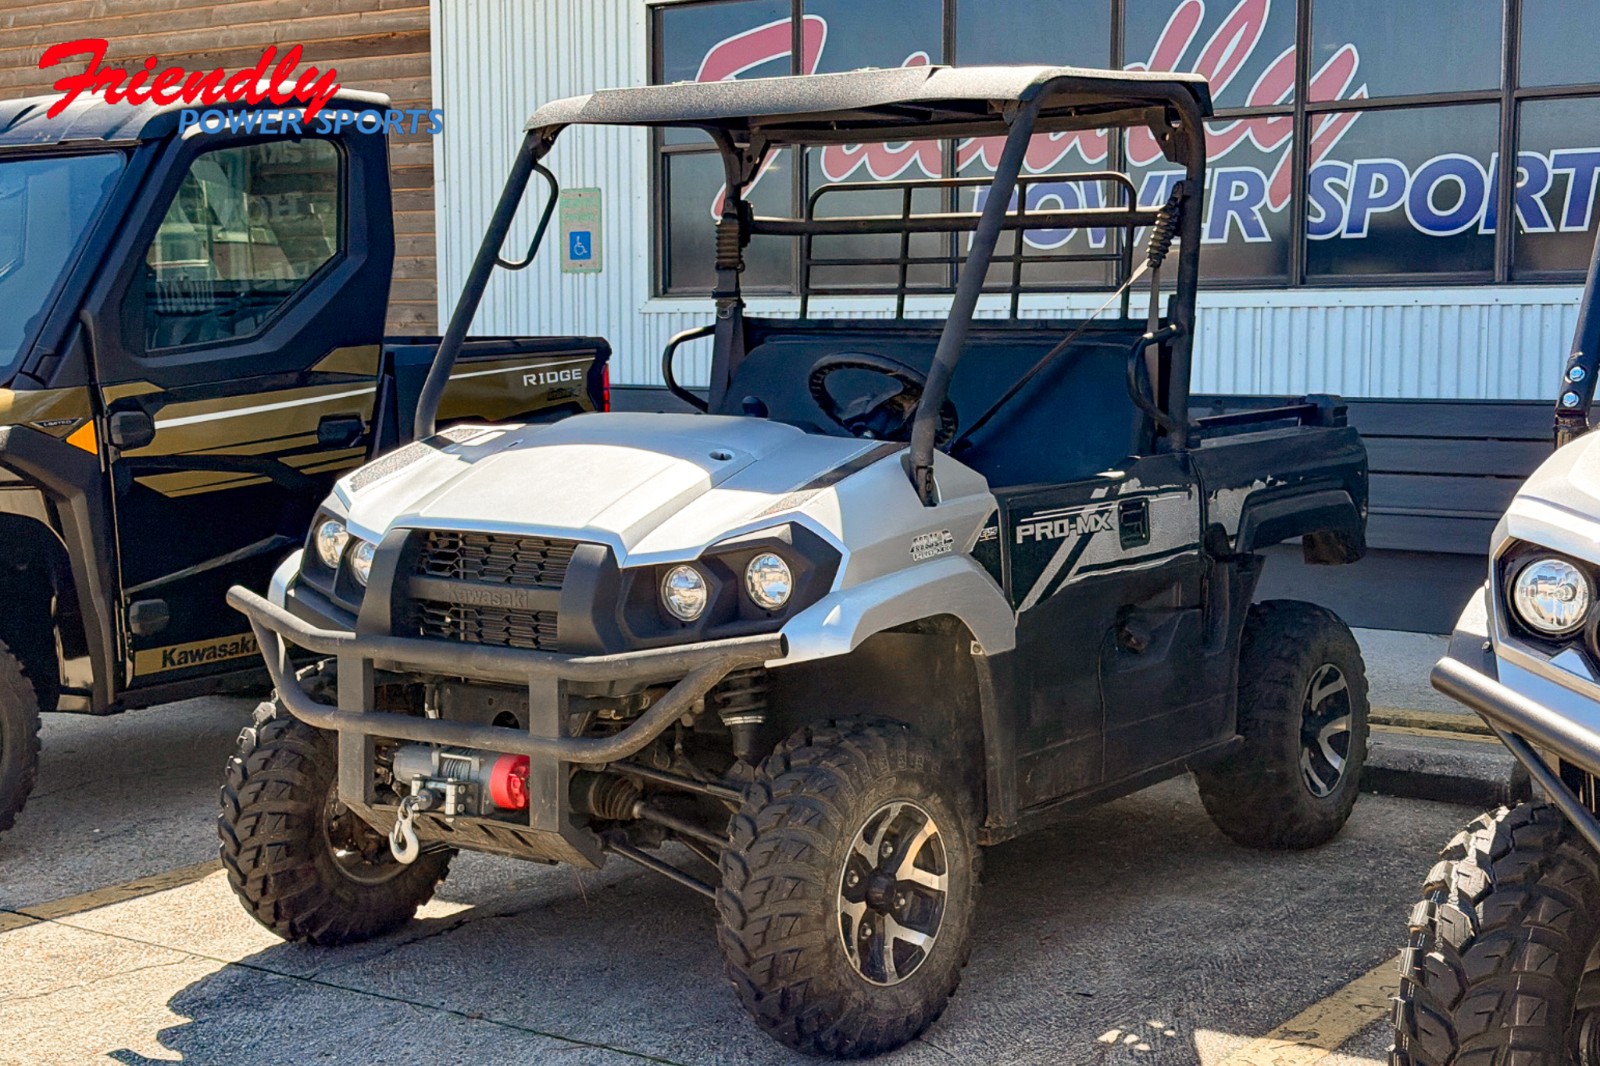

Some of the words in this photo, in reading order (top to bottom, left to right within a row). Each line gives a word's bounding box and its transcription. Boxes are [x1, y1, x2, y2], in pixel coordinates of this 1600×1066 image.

[695, 0, 1368, 221] Fdly
[966, 165, 1272, 251] OWR
[523, 368, 583, 387] RIDGE
[1016, 510, 1114, 544] PRO-MX
[448, 582, 529, 609] Kawasaki
[161, 636, 259, 668] Kawasaki
